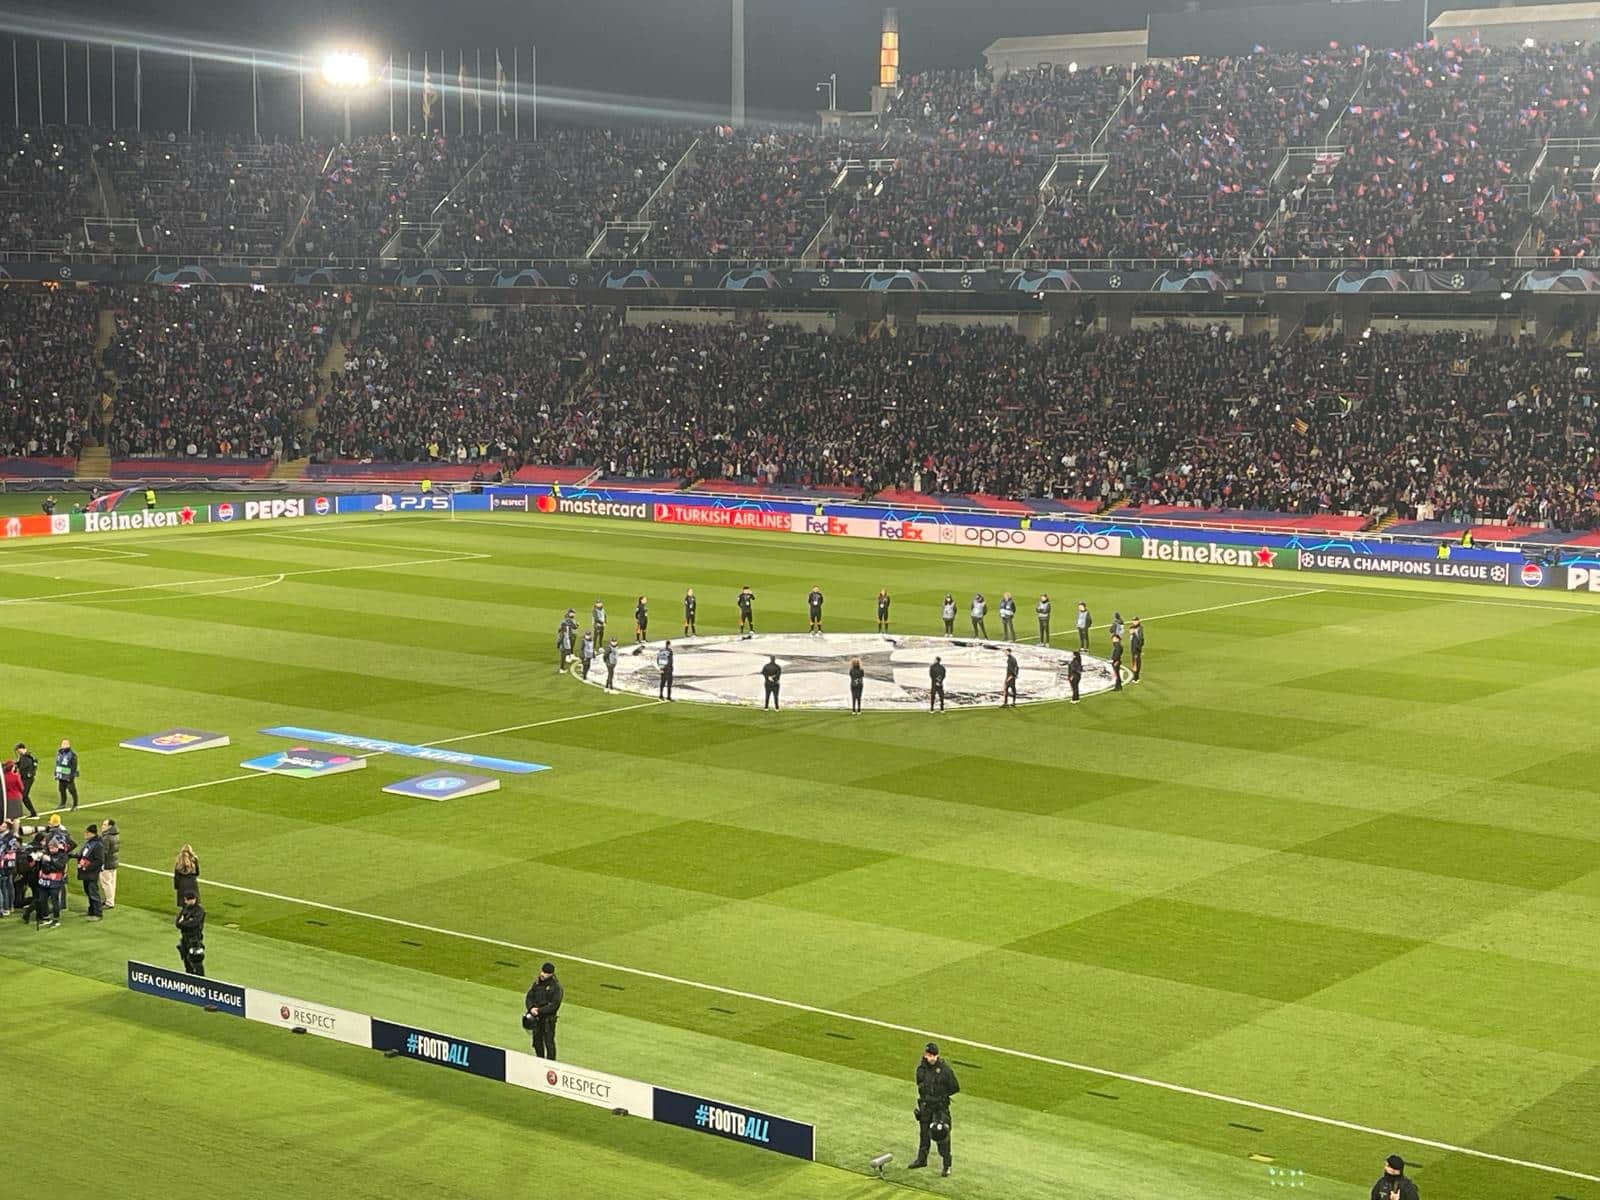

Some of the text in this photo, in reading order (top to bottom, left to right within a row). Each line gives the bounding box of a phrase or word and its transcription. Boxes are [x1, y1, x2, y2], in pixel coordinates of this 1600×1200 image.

[245, 498, 305, 520] PEPSI
[400, 496, 449, 509] PS5
[560, 497, 646, 518] mastercard
[84, 508, 179, 532] Heineken
[675, 507, 791, 529] TURKISH AIRLINES
[806, 516, 848, 535] FedEx
[879, 521, 923, 540] FedEx
[964, 527, 1026, 546] oppo
[1044, 532, 1110, 551] oppo
[1142, 538, 1253, 567] Heineken
[1317, 556, 1488, 579] UEFA CHAMPIONS LEAGUE
[131, 971, 242, 1008] UEFA CHAMPIONS LEAGUE
[293, 1009, 336, 1030] RESPECT
[406, 1033, 470, 1066] #FOOTBALL
[561, 1074, 612, 1099] RESPECT
[695, 1104, 770, 1142] #FOOTBALL
